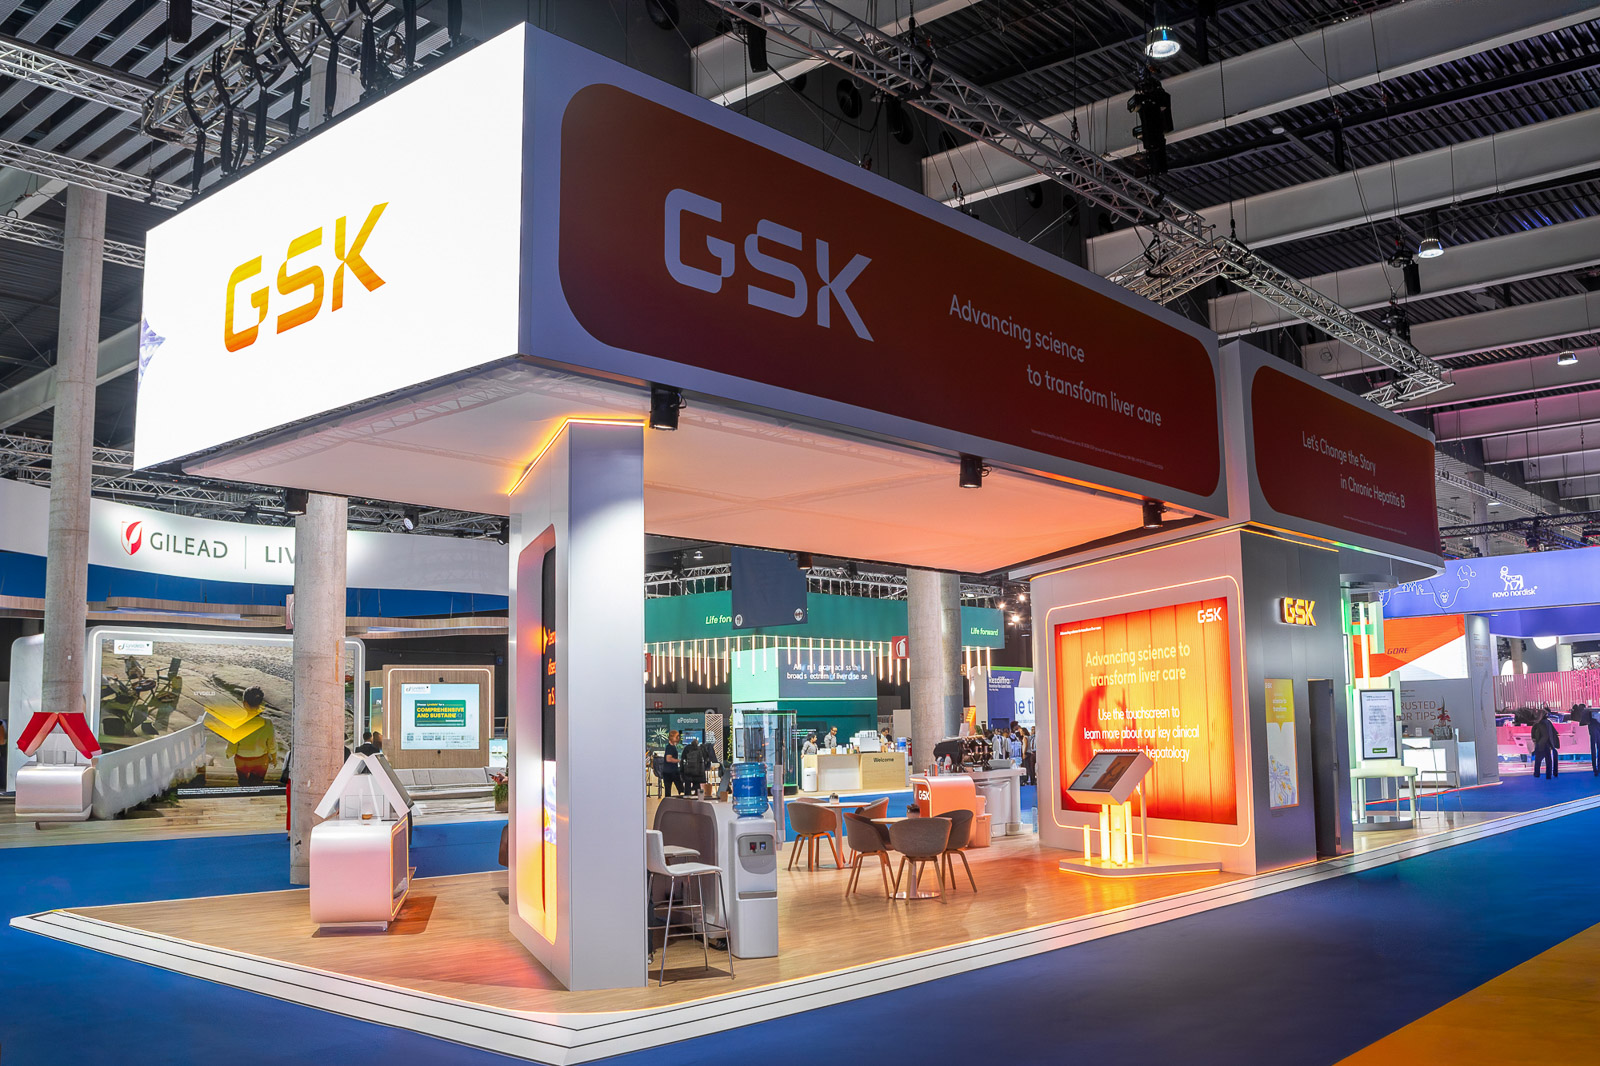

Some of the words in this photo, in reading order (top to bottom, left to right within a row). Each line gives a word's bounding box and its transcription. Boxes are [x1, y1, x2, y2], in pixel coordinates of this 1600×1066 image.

[664, 188, 875, 343] GSK
[224, 201, 389, 353] GSK
[949, 294, 1032, 350] Advancing
[1035, 331, 1085, 363] science
[1026, 364, 1042, 387] to
[1045, 370, 1108, 409] transform
[1110, 391, 1135, 418] liver
[1137, 404, 1162, 427] care
[1302, 430, 1319, 452] Let's
[1319, 438, 1348, 465] Change
[1347, 450, 1359, 467] the
[1359, 453, 1376, 477] Story
[1340, 473, 1348, 490] in
[1348, 476, 1373, 499] Chronic
[1373, 484, 1401, 507] Hepatitis
[1400, 494, 1406, 509] B
[150, 532, 228, 559] GILEAD
[1510, 588, 1536, 597] nordisk
[705, 615, 719, 625] Life
[1197, 606, 1222, 624] GSK
[1281, 597, 1317, 627] GSK
[970, 627, 980, 636] Life
[980, 627, 999, 636] forward
[1085, 648, 1136, 667] Advancing
[1138, 645, 1176, 661] science
[1178, 641, 1191, 657] to
[1090, 668, 1137, 687] transform
[1139, 667, 1160, 683] liver
[1162, 667, 1187, 681] care
[1098, 708, 1112, 721] Use
[1112, 707, 1125, 720] the
[1125, 705, 1171, 720] touchscreen
[1171, 705, 1180, 718] to
[1415, 711, 1437, 721] TIPS
[1083, 727, 1101, 740] learn
[1102, 729, 1120, 740] more
[1121, 726, 1143, 739] about
[1143, 729, 1157, 739] our
[1157, 725, 1171, 742] key
[1172, 724, 1200, 738] clinical
[1145, 744, 1190, 762] hepatology
[918, 789, 930, 801] GSK
